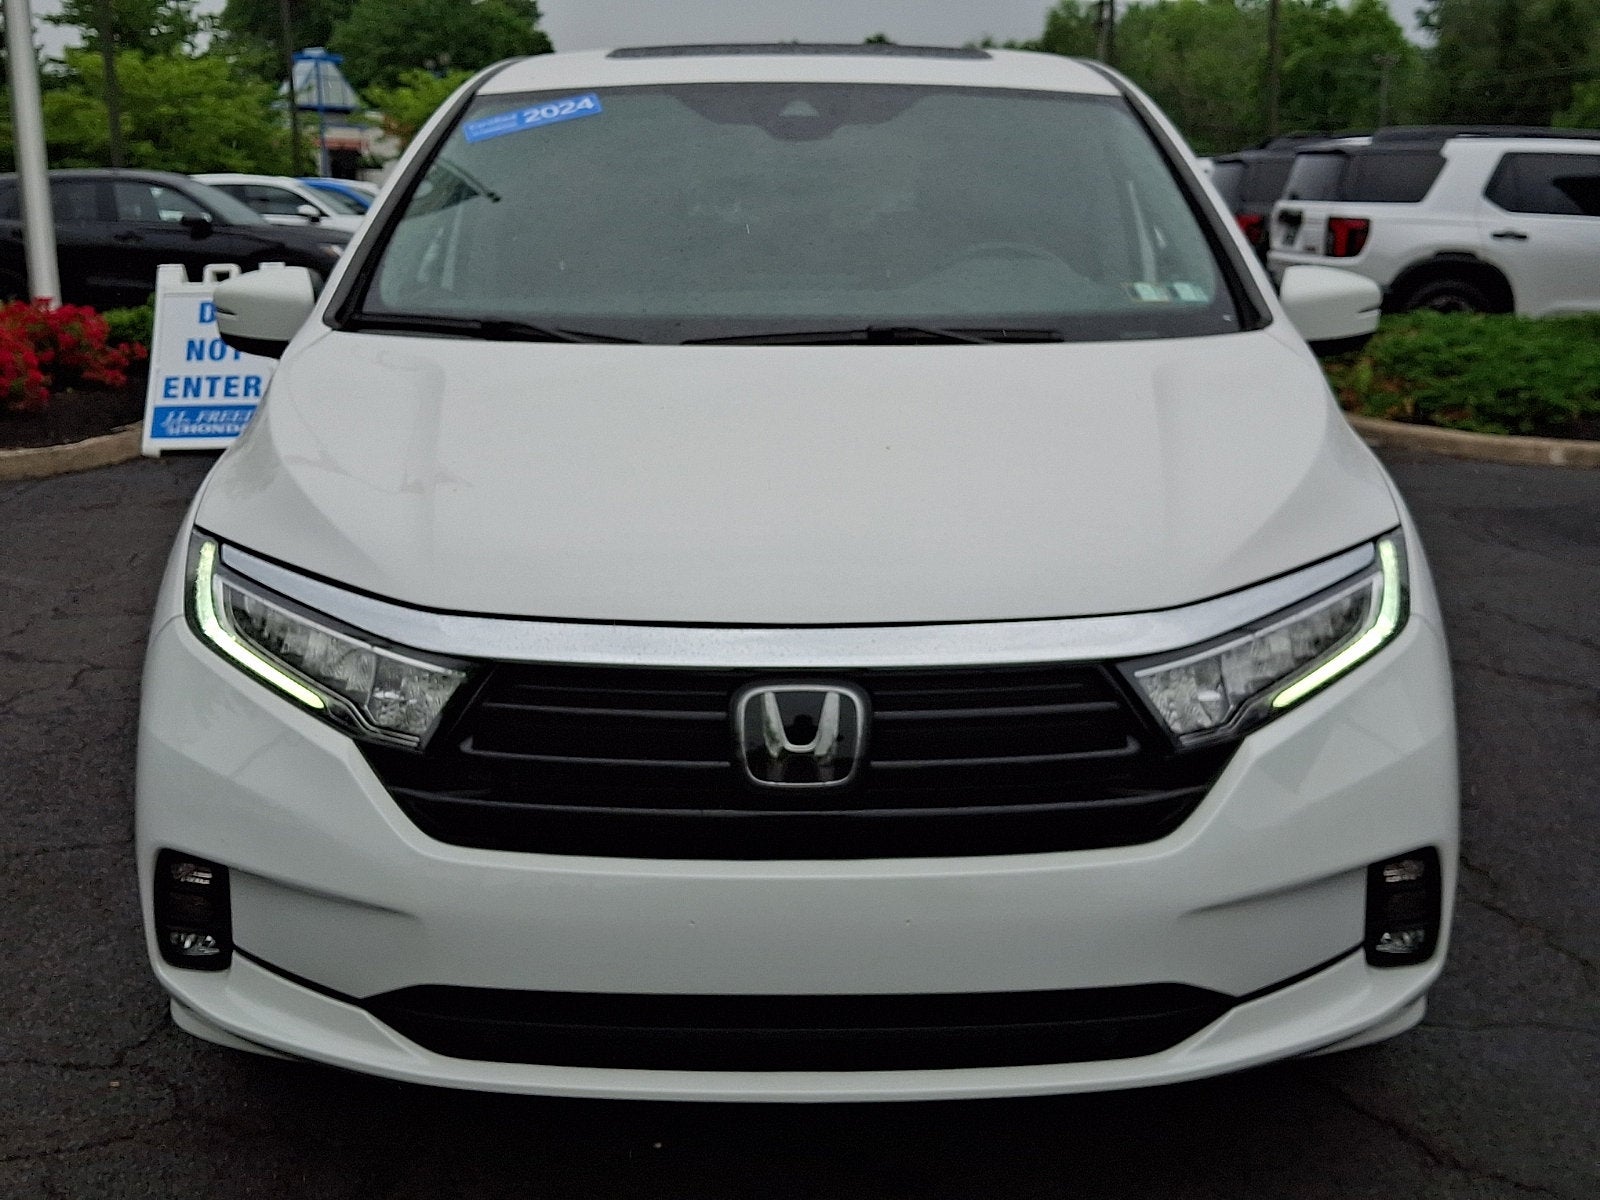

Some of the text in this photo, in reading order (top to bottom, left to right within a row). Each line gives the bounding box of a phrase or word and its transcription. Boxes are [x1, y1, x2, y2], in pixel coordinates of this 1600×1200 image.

[523, 97, 594, 123] 2024
[199, 302, 217, 324] D
[163, 376, 262, 398] ENTER
